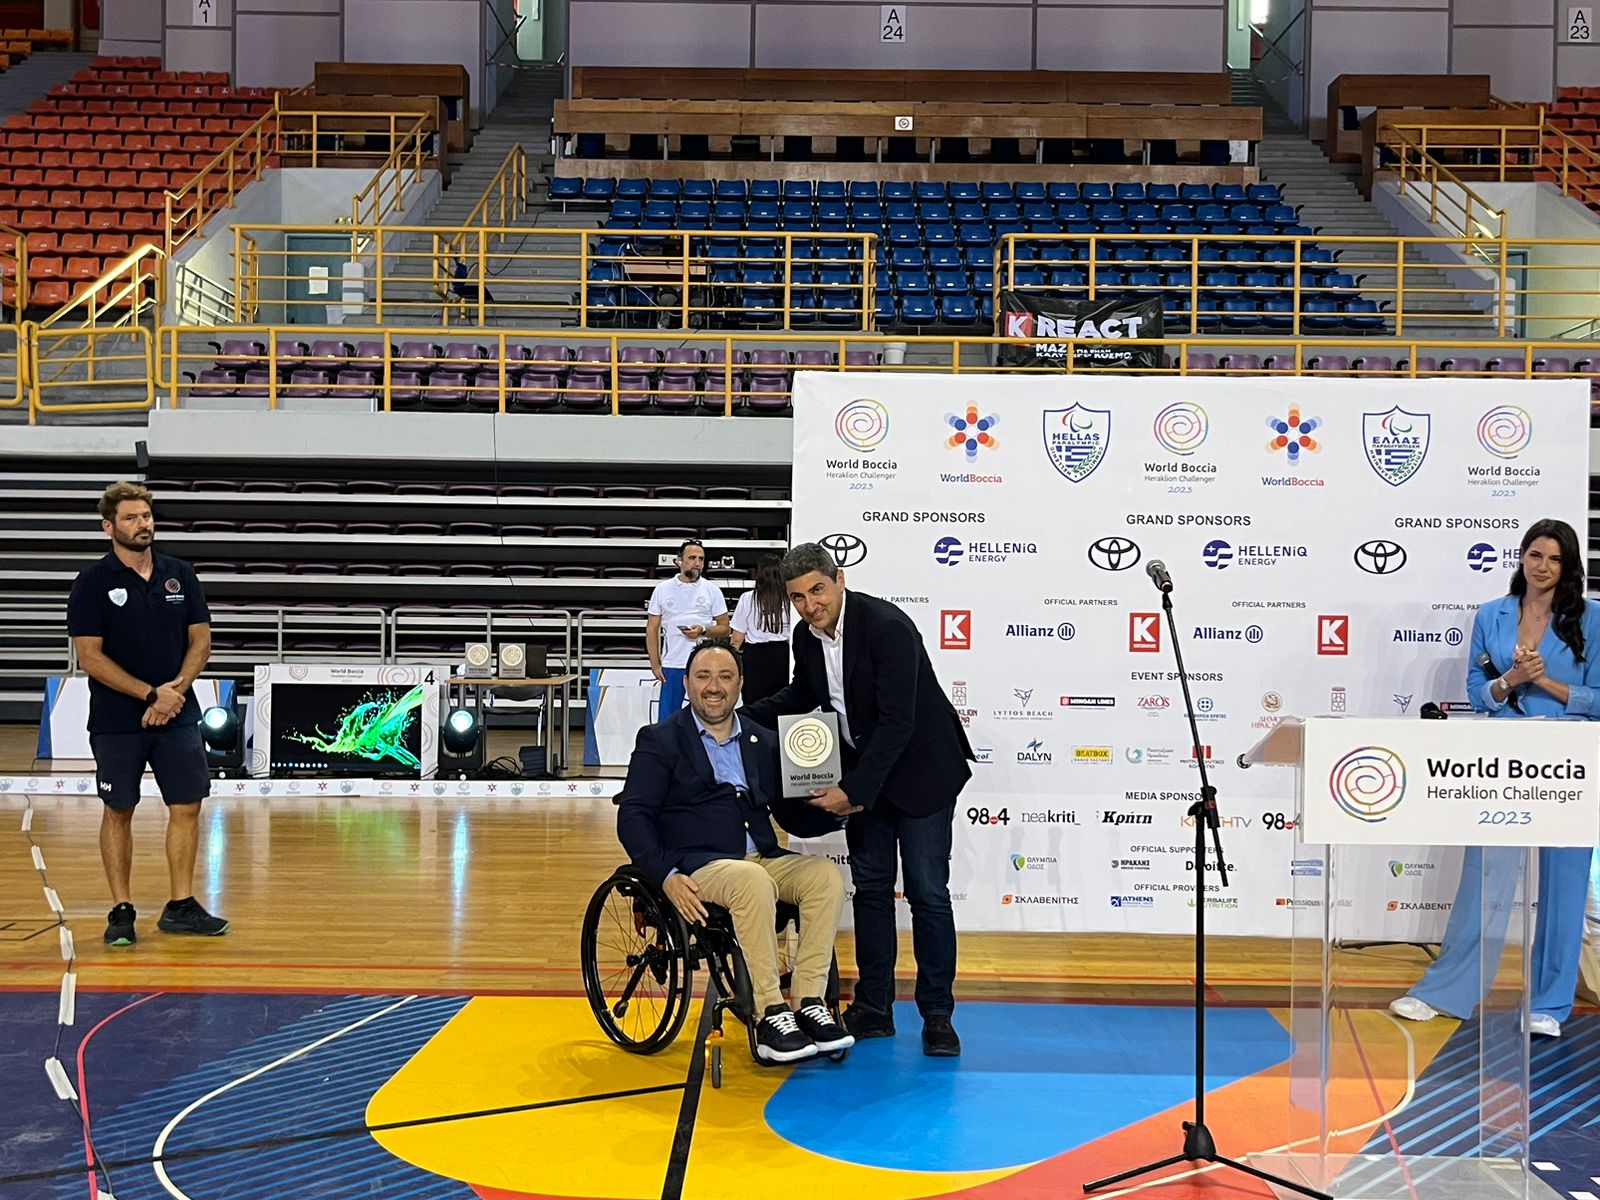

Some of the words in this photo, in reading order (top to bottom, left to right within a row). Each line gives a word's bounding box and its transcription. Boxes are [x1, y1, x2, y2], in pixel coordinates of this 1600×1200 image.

[202, 9, 208, 23] 1
[887, 9, 900, 23] A
[1574, 10, 1586, 24] A
[883, 25, 904, 40] 24
[1570, 25, 1590, 40] 23
[1008, 315, 1028, 338] K
[1037, 315, 1143, 339] REACT
[1052, 433, 1100, 441] HELLAS
[826, 459, 859, 470] World
[862, 460, 898, 470] Boccia
[1144, 462, 1178, 473] World
[1181, 463, 1217, 473] Boccia
[860, 472, 896, 480] Challenger
[1467, 466, 1501, 476] World
[1504, 466, 1541, 476] Boccia
[1178, 475, 1216, 484] Challenger
[1467, 478, 1501, 486] Heraklion
[1502, 478, 1539, 487] Challenger
[849, 482, 874, 490] 2023
[1167, 485, 1193, 494] 2023
[862, 511, 909, 522] GRAND
[913, 512, 986, 523] SPONSORS
[1126, 514, 1174, 525] GRAND
[1177, 515, 1251, 526] SPONSORS
[1394, 518, 1442, 528] GRAND
[1445, 518, 1520, 529] SPONSORS
[1238, 558, 1277, 566] ENERGY
[944, 614, 967, 640] K
[1005, 624, 1054, 637] Allianz
[1133, 617, 1157, 642] K
[1321, 619, 1345, 645] K
[1192, 627, 1242, 640] Allianz
[1392, 629, 1442, 642] Allianz
[424, 670, 435, 685] 4
[1131, 671, 1164, 681] EVENT
[1136, 696, 1170, 708] ZAROS
[1017, 752, 1052, 761] DALYN
[1075, 750, 1108, 758] BEATBOX
[1427, 758, 1499, 778] World
[1507, 759, 1586, 779] Boccia
[790, 772, 810, 781] World
[811, 771, 834, 780] Boccia
[1125, 792, 1157, 800] MEDIA
[1427, 785, 1498, 799] Heraklion
[1502, 786, 1584, 803] Challenger
[1477, 811, 1533, 825] 2023
[1130, 845, 1167, 853] OFFICIAL
[1134, 883, 1170, 891] OFFICIAL
[1014, 896, 1079, 905] ΣΚΛΑΒΕΝΙΤΗΣ
